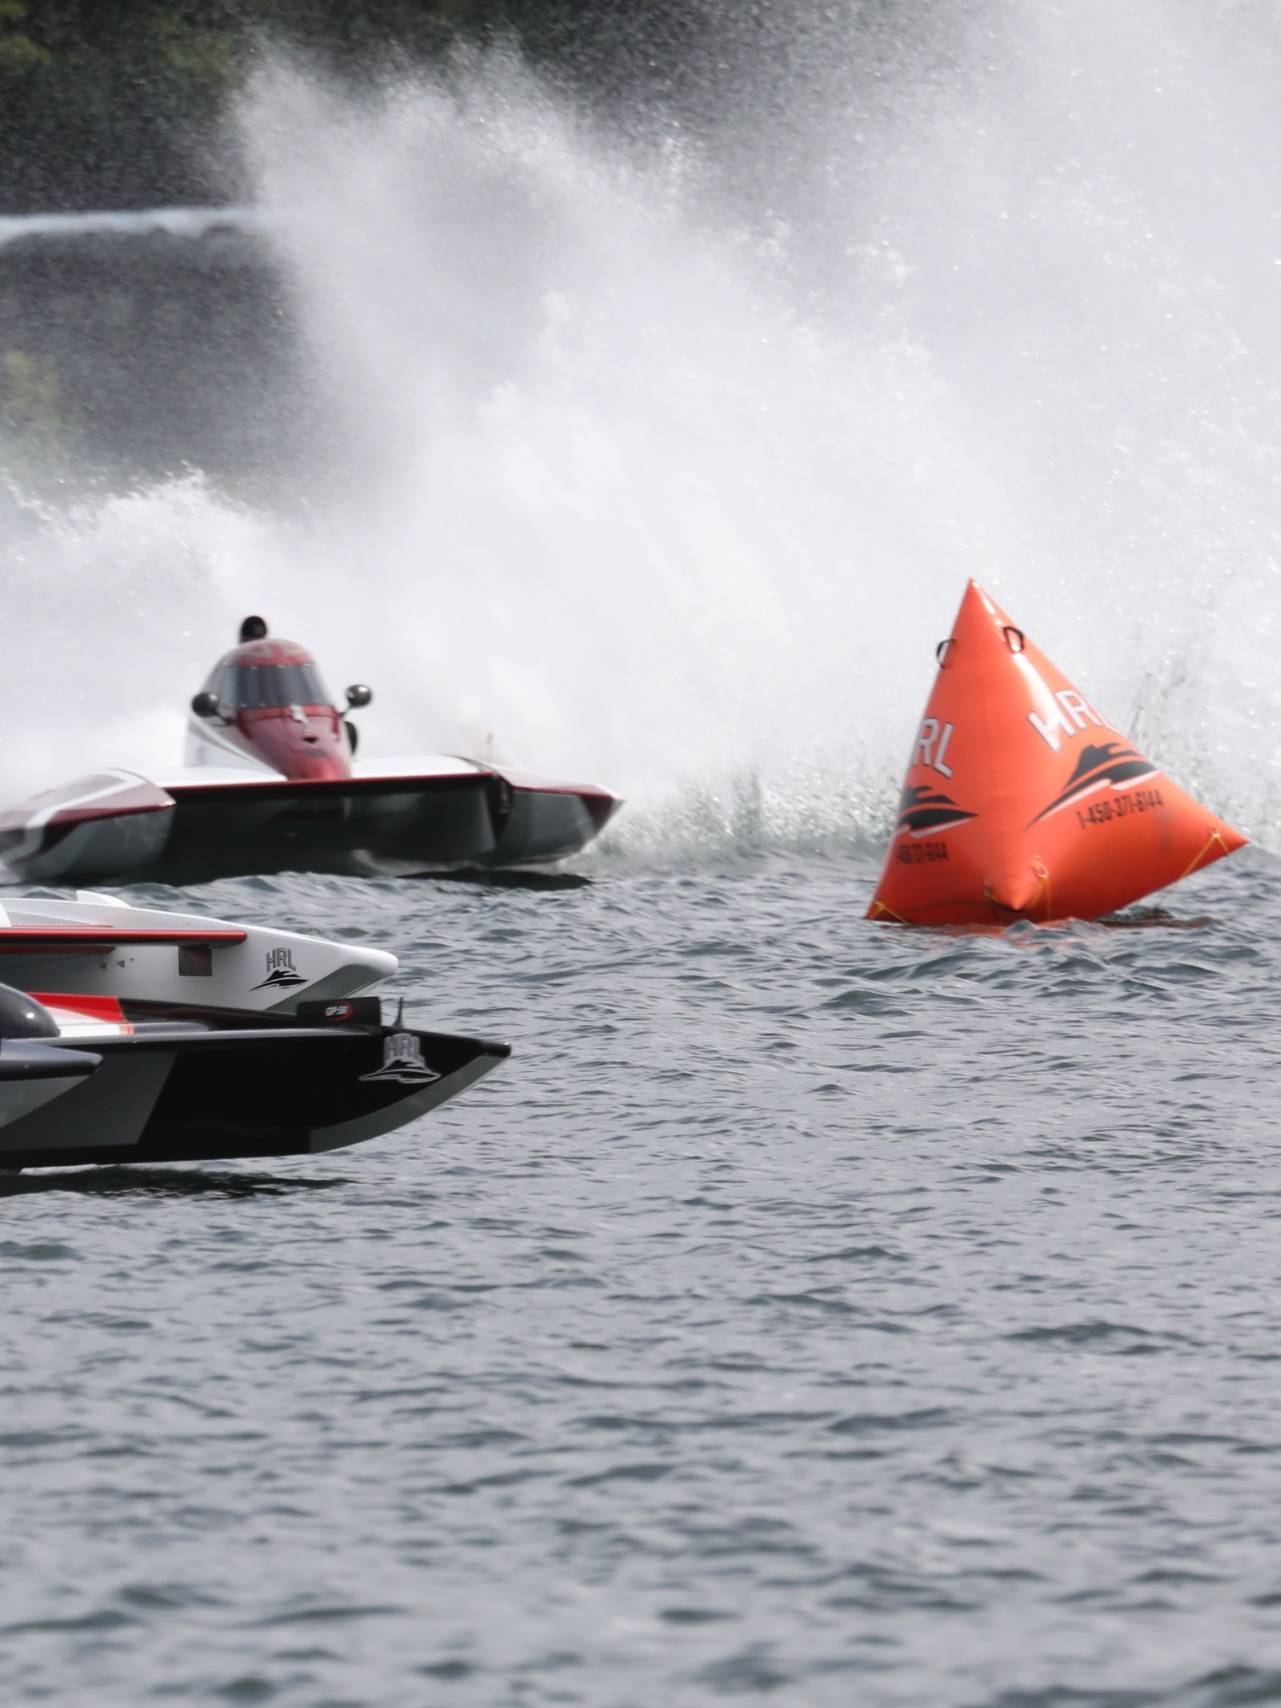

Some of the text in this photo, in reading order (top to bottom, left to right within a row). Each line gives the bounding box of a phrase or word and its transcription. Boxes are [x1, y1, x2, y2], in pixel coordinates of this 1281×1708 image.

[911, 717, 954, 779] RL
[266, 947, 297, 972] HRL
[384, 1033, 426, 1067] HRL
